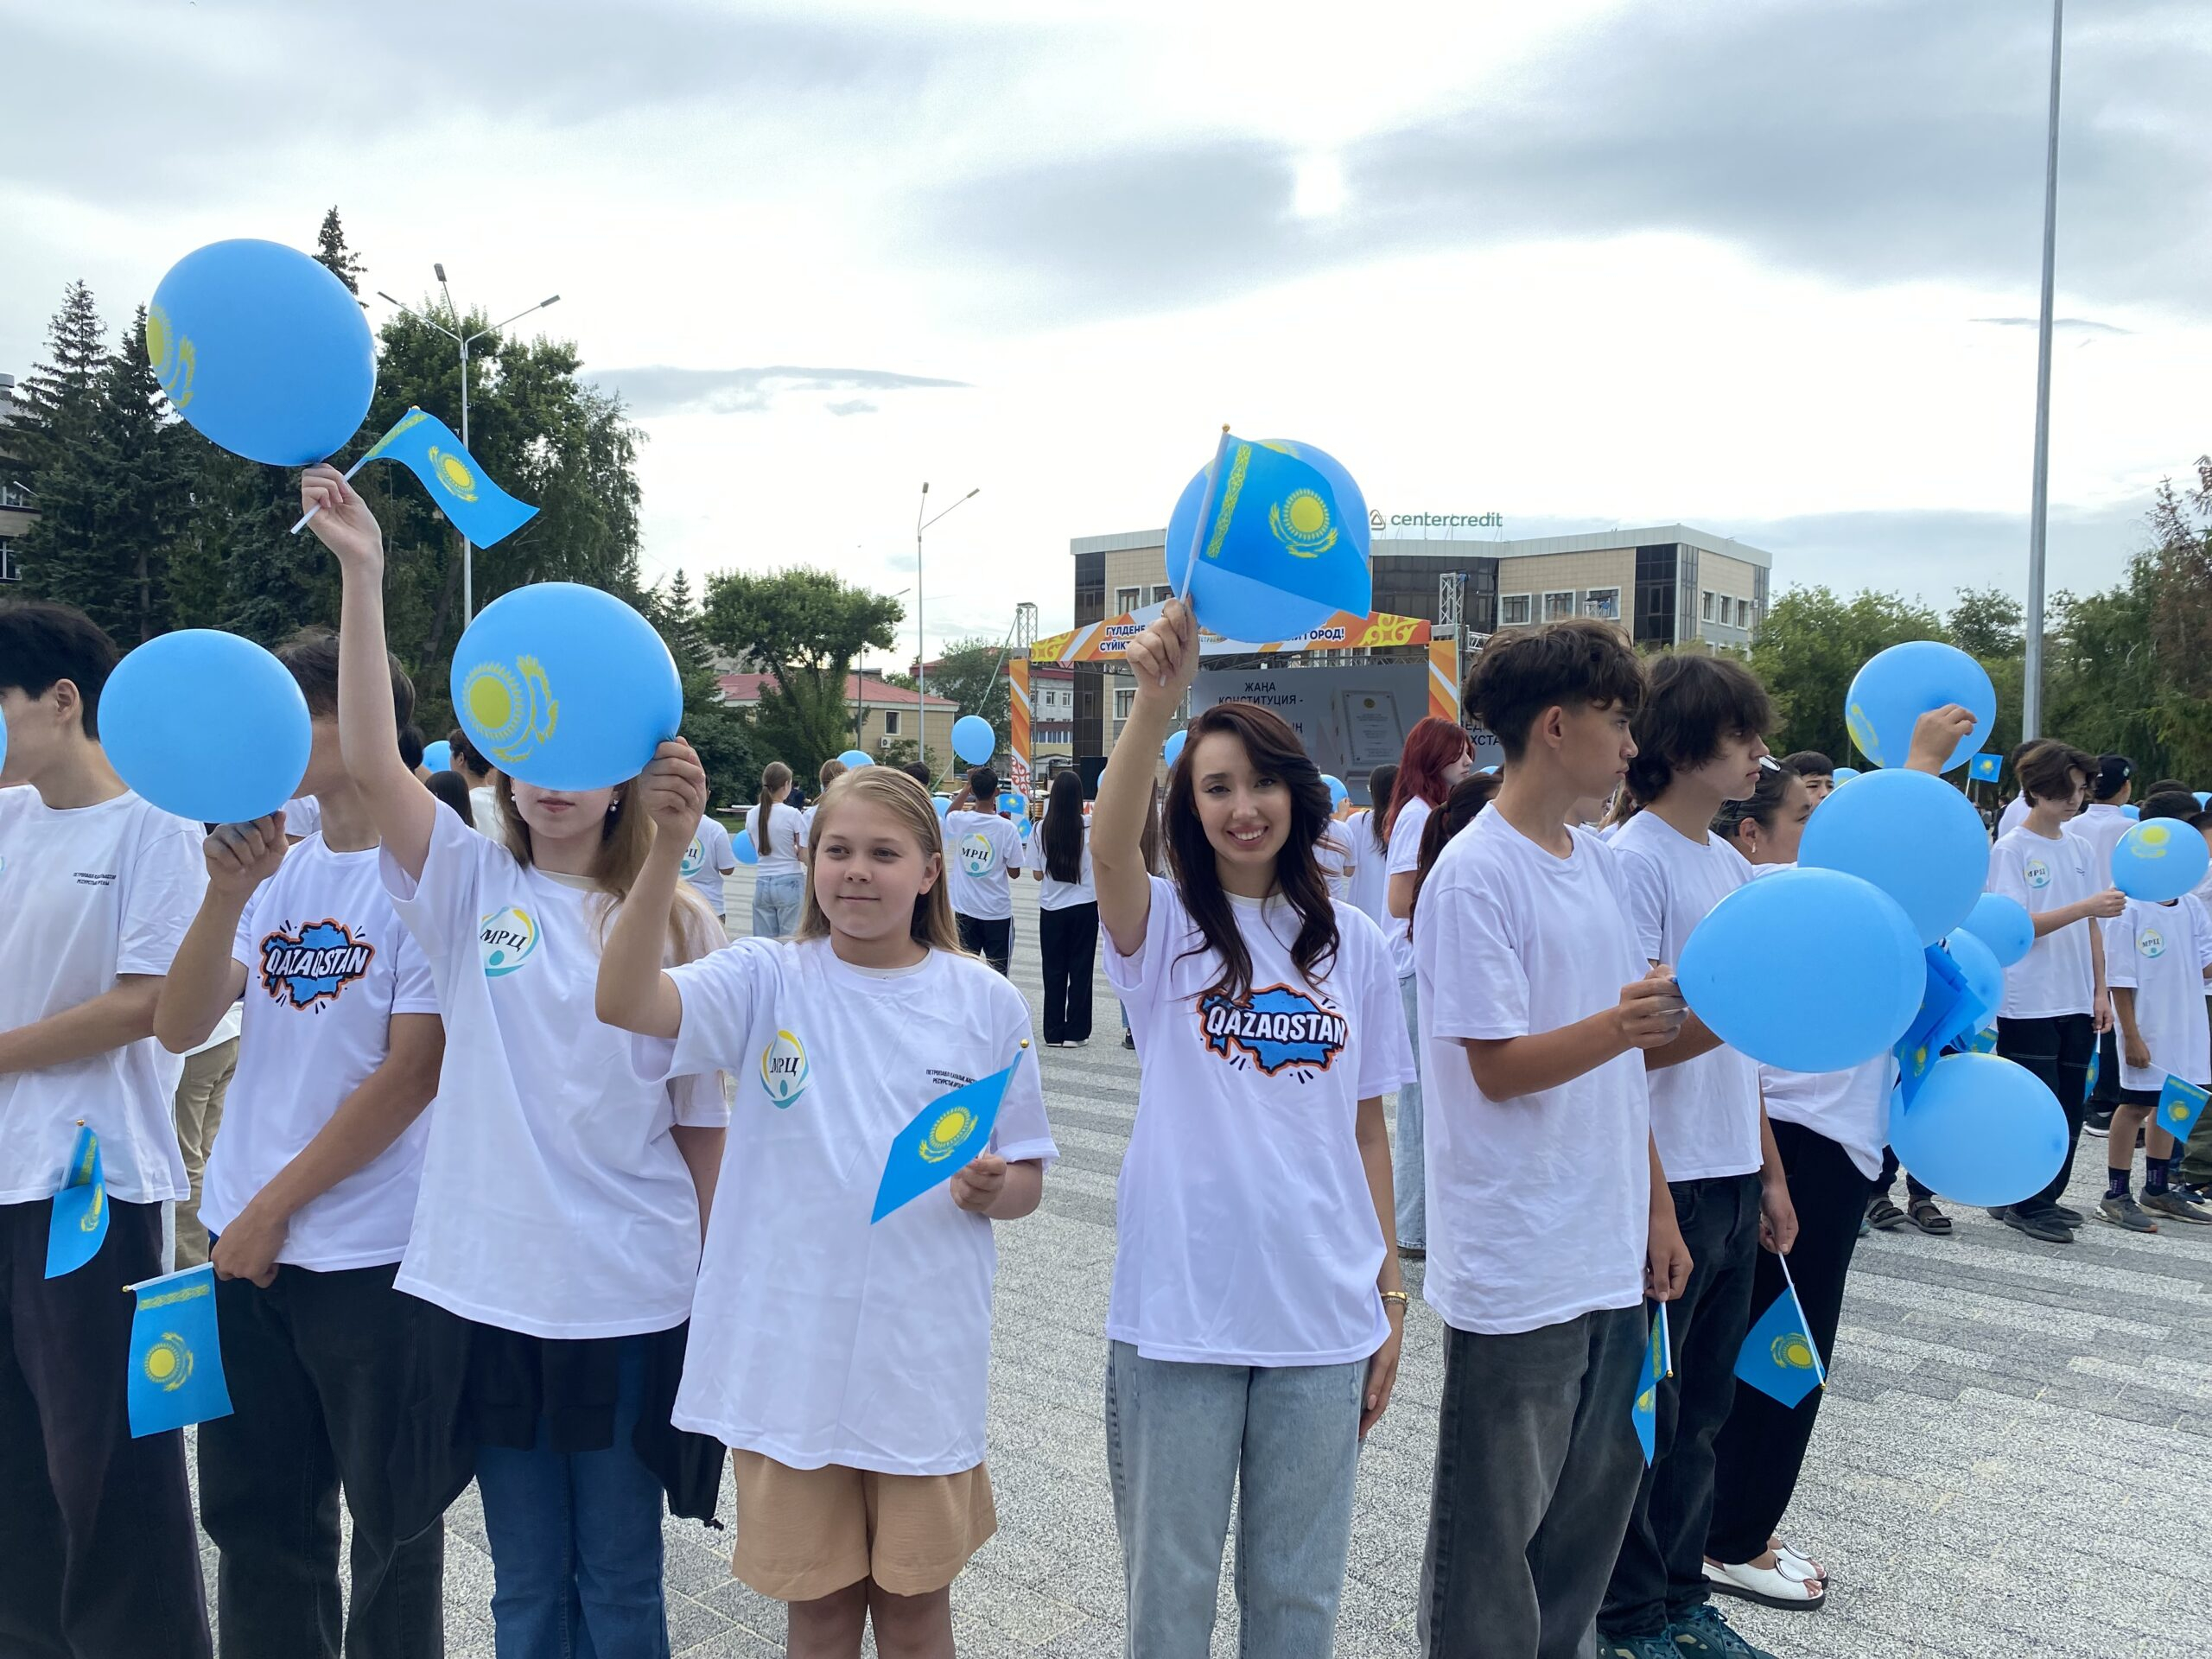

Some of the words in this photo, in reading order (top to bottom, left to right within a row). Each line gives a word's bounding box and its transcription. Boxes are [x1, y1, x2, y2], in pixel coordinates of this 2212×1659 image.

[1390, 512, 1503, 527] centercredit
[1244, 682, 1276, 693] ЖАҢА
[961, 847, 989, 862] МРЦ
[480, 928, 529, 952] МРЦ
[265, 946, 369, 977] QAZAQSTAN
[1206, 1006, 1346, 1046] QAZAQSTAN
[770, 1057, 800, 1077] МРЦ
